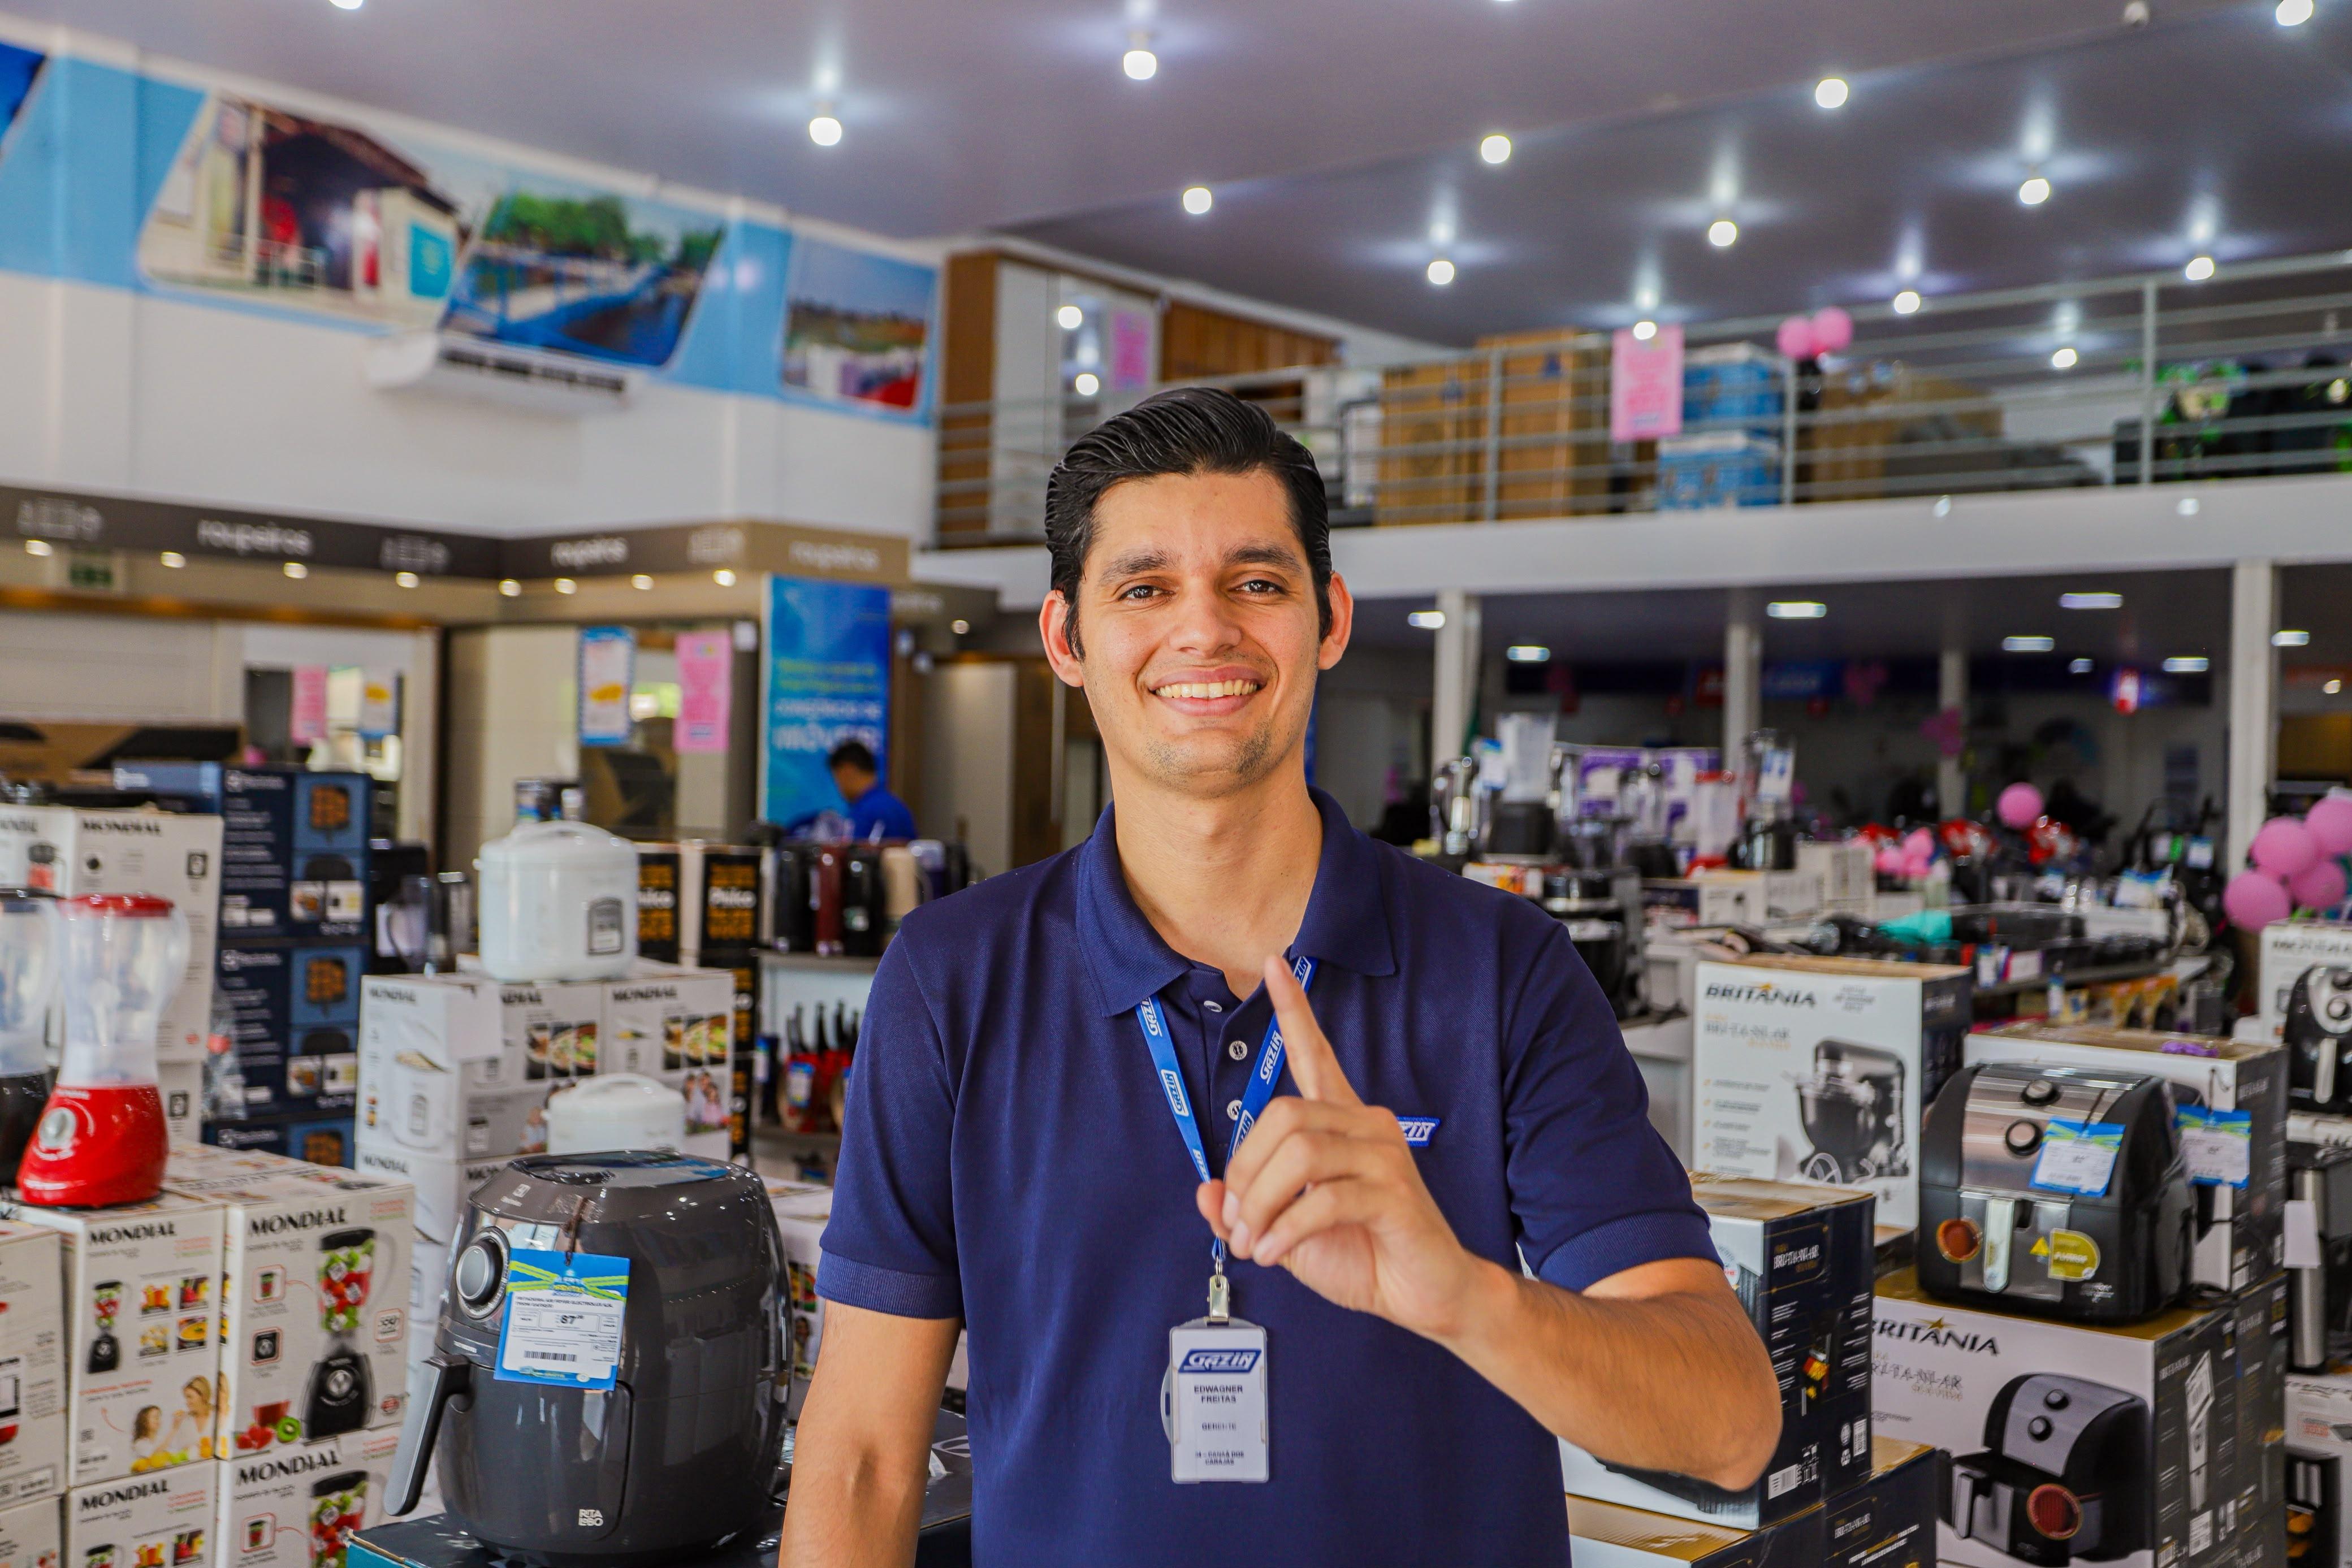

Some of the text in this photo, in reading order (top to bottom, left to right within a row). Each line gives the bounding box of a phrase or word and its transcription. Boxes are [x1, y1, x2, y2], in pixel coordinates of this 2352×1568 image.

[1260, 1030, 1284, 1085] GAZIN
[1164, 1072, 1187, 1114] GAZIN
[90, 1221, 177, 1245] MONDIAL
[249, 1207, 347, 1236] MONDIAL
[1871, 1316, 2000, 1357] RITANIA
[1183, 1352, 1256, 1372] GAZIN
[1194, 1385, 1243, 1393] EDWAGNER
[235, 1450, 341, 1487] MONDIAL
[80, 1479, 171, 1512] MONDIAL
[579, 1509, 603, 1518] RITA
